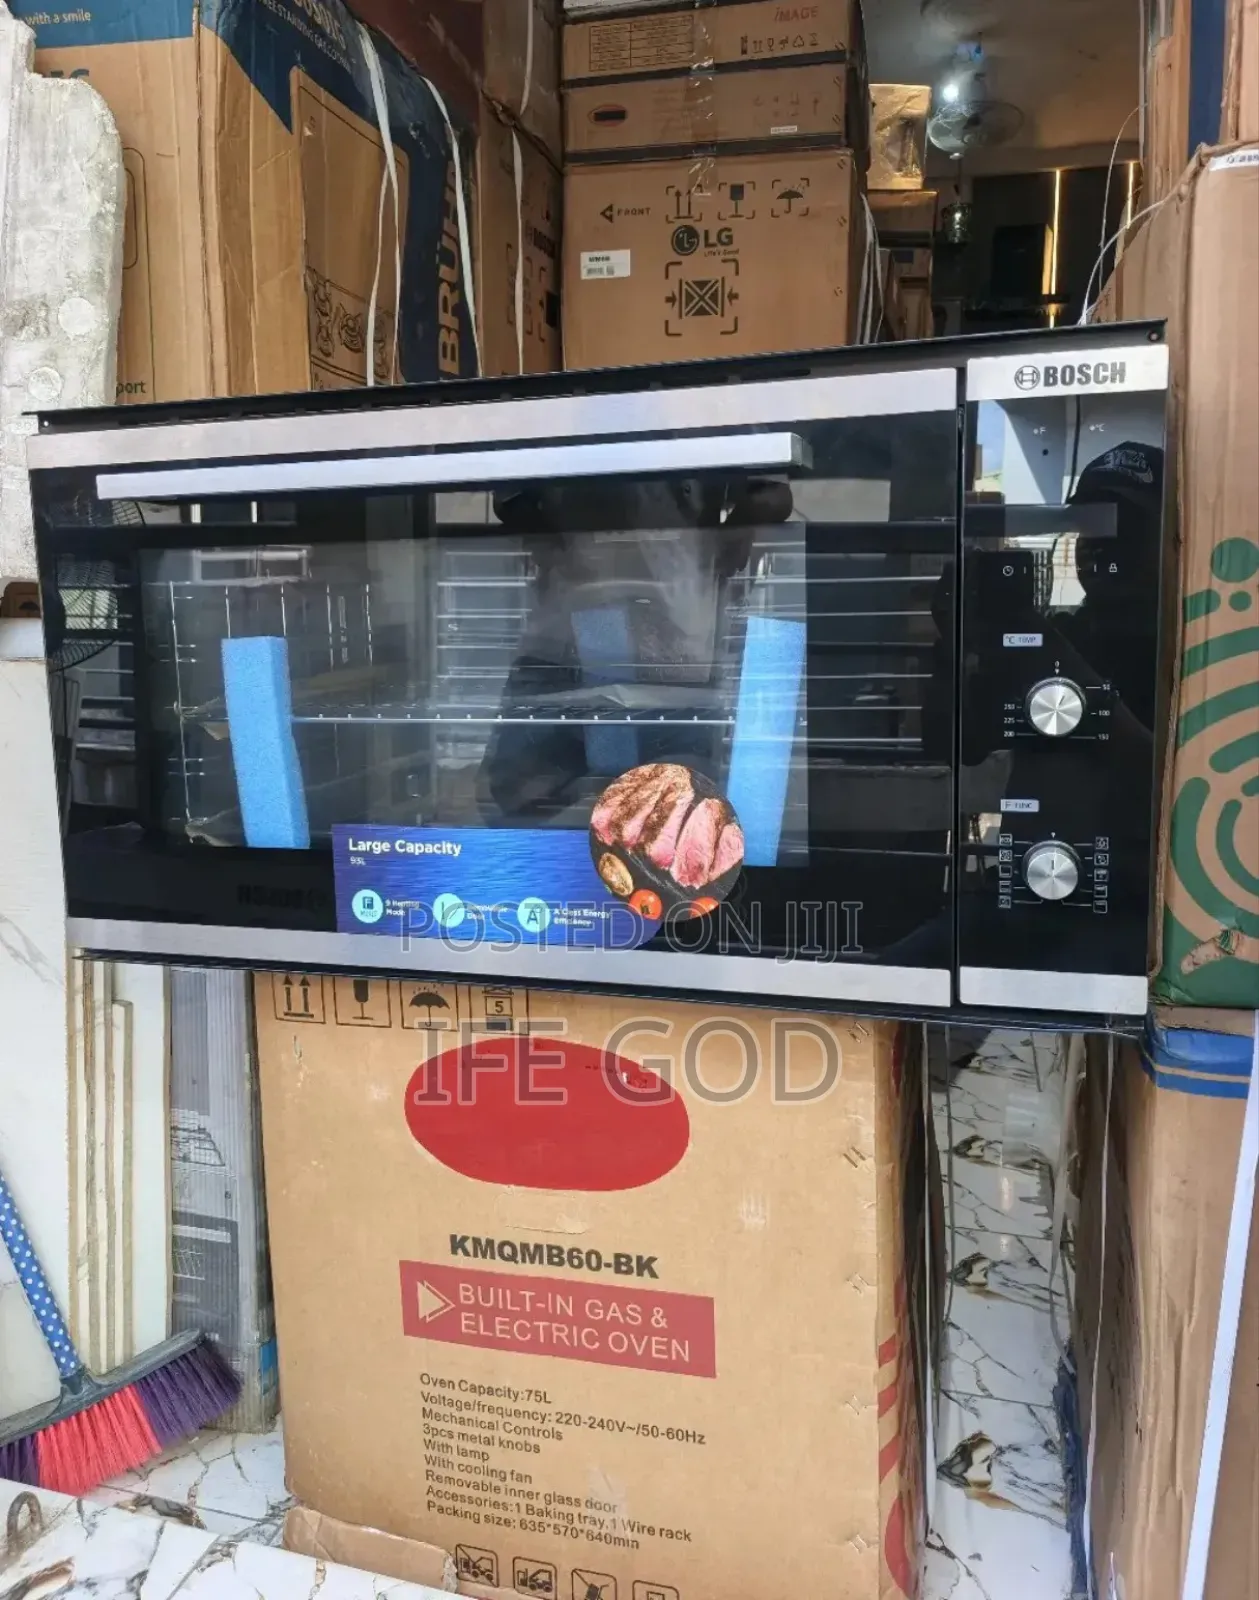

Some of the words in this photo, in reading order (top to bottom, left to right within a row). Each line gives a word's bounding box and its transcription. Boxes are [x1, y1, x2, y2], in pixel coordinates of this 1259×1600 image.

[26, 12, 51, 26] with
[53, 14, 60, 24] a
[62, 8, 91, 23] smile
[617, 207, 651, 217] FRONT
[704, 227, 734, 248] LG
[1043, 362, 1127, 387] BOSCH
[348, 838, 391, 853] Large
[395, 840, 462, 857] Capacity
[494, 1000, 504, 1014] 5
[449, 1233, 659, 1279] KMQMB60-BK
[458, 1283, 574, 1317] BUILT-IN
[585, 1299, 642, 1326] GAS
[650, 1306, 668, 1329] &
[460, 1312, 600, 1350] ELECTRIC
[607, 1331, 690, 1363] OVEN
[420, 1373, 456, 1391] Oven
[458, 1380, 552, 1404] Capacity:75L
[420, 1391, 553, 1423] Voltage/frequency:
[555, 1411, 706, 1445] 220-240V~/50-60Hz
[422, 1407, 499, 1431] Mechanical
[503, 1422, 563, 1441] Controls
[422, 1423, 455, 1440] 3pcs
[457, 1430, 495, 1447] metal
[498, 1435, 541, 1454] knobs
[423, 1438, 453, 1455] With
[456, 1442, 490, 1462] lamp
[424, 1454, 454, 1471] With
[457, 1461, 507, 1482] cooling
[510, 1468, 532, 1485] fan
[425, 1470, 501, 1495] Removable
[504, 1485, 540, 1502] inner
[544, 1491, 581, 1509] glass
[585, 1496, 618, 1514] door
[427, 1500, 481, 1524] Packing
[483, 1512, 517, 1530] size:
[525, 1504, 574, 1525] Baking
[621, 1517, 656, 1537] Wire
[659, 1526, 693, 1543] rack
